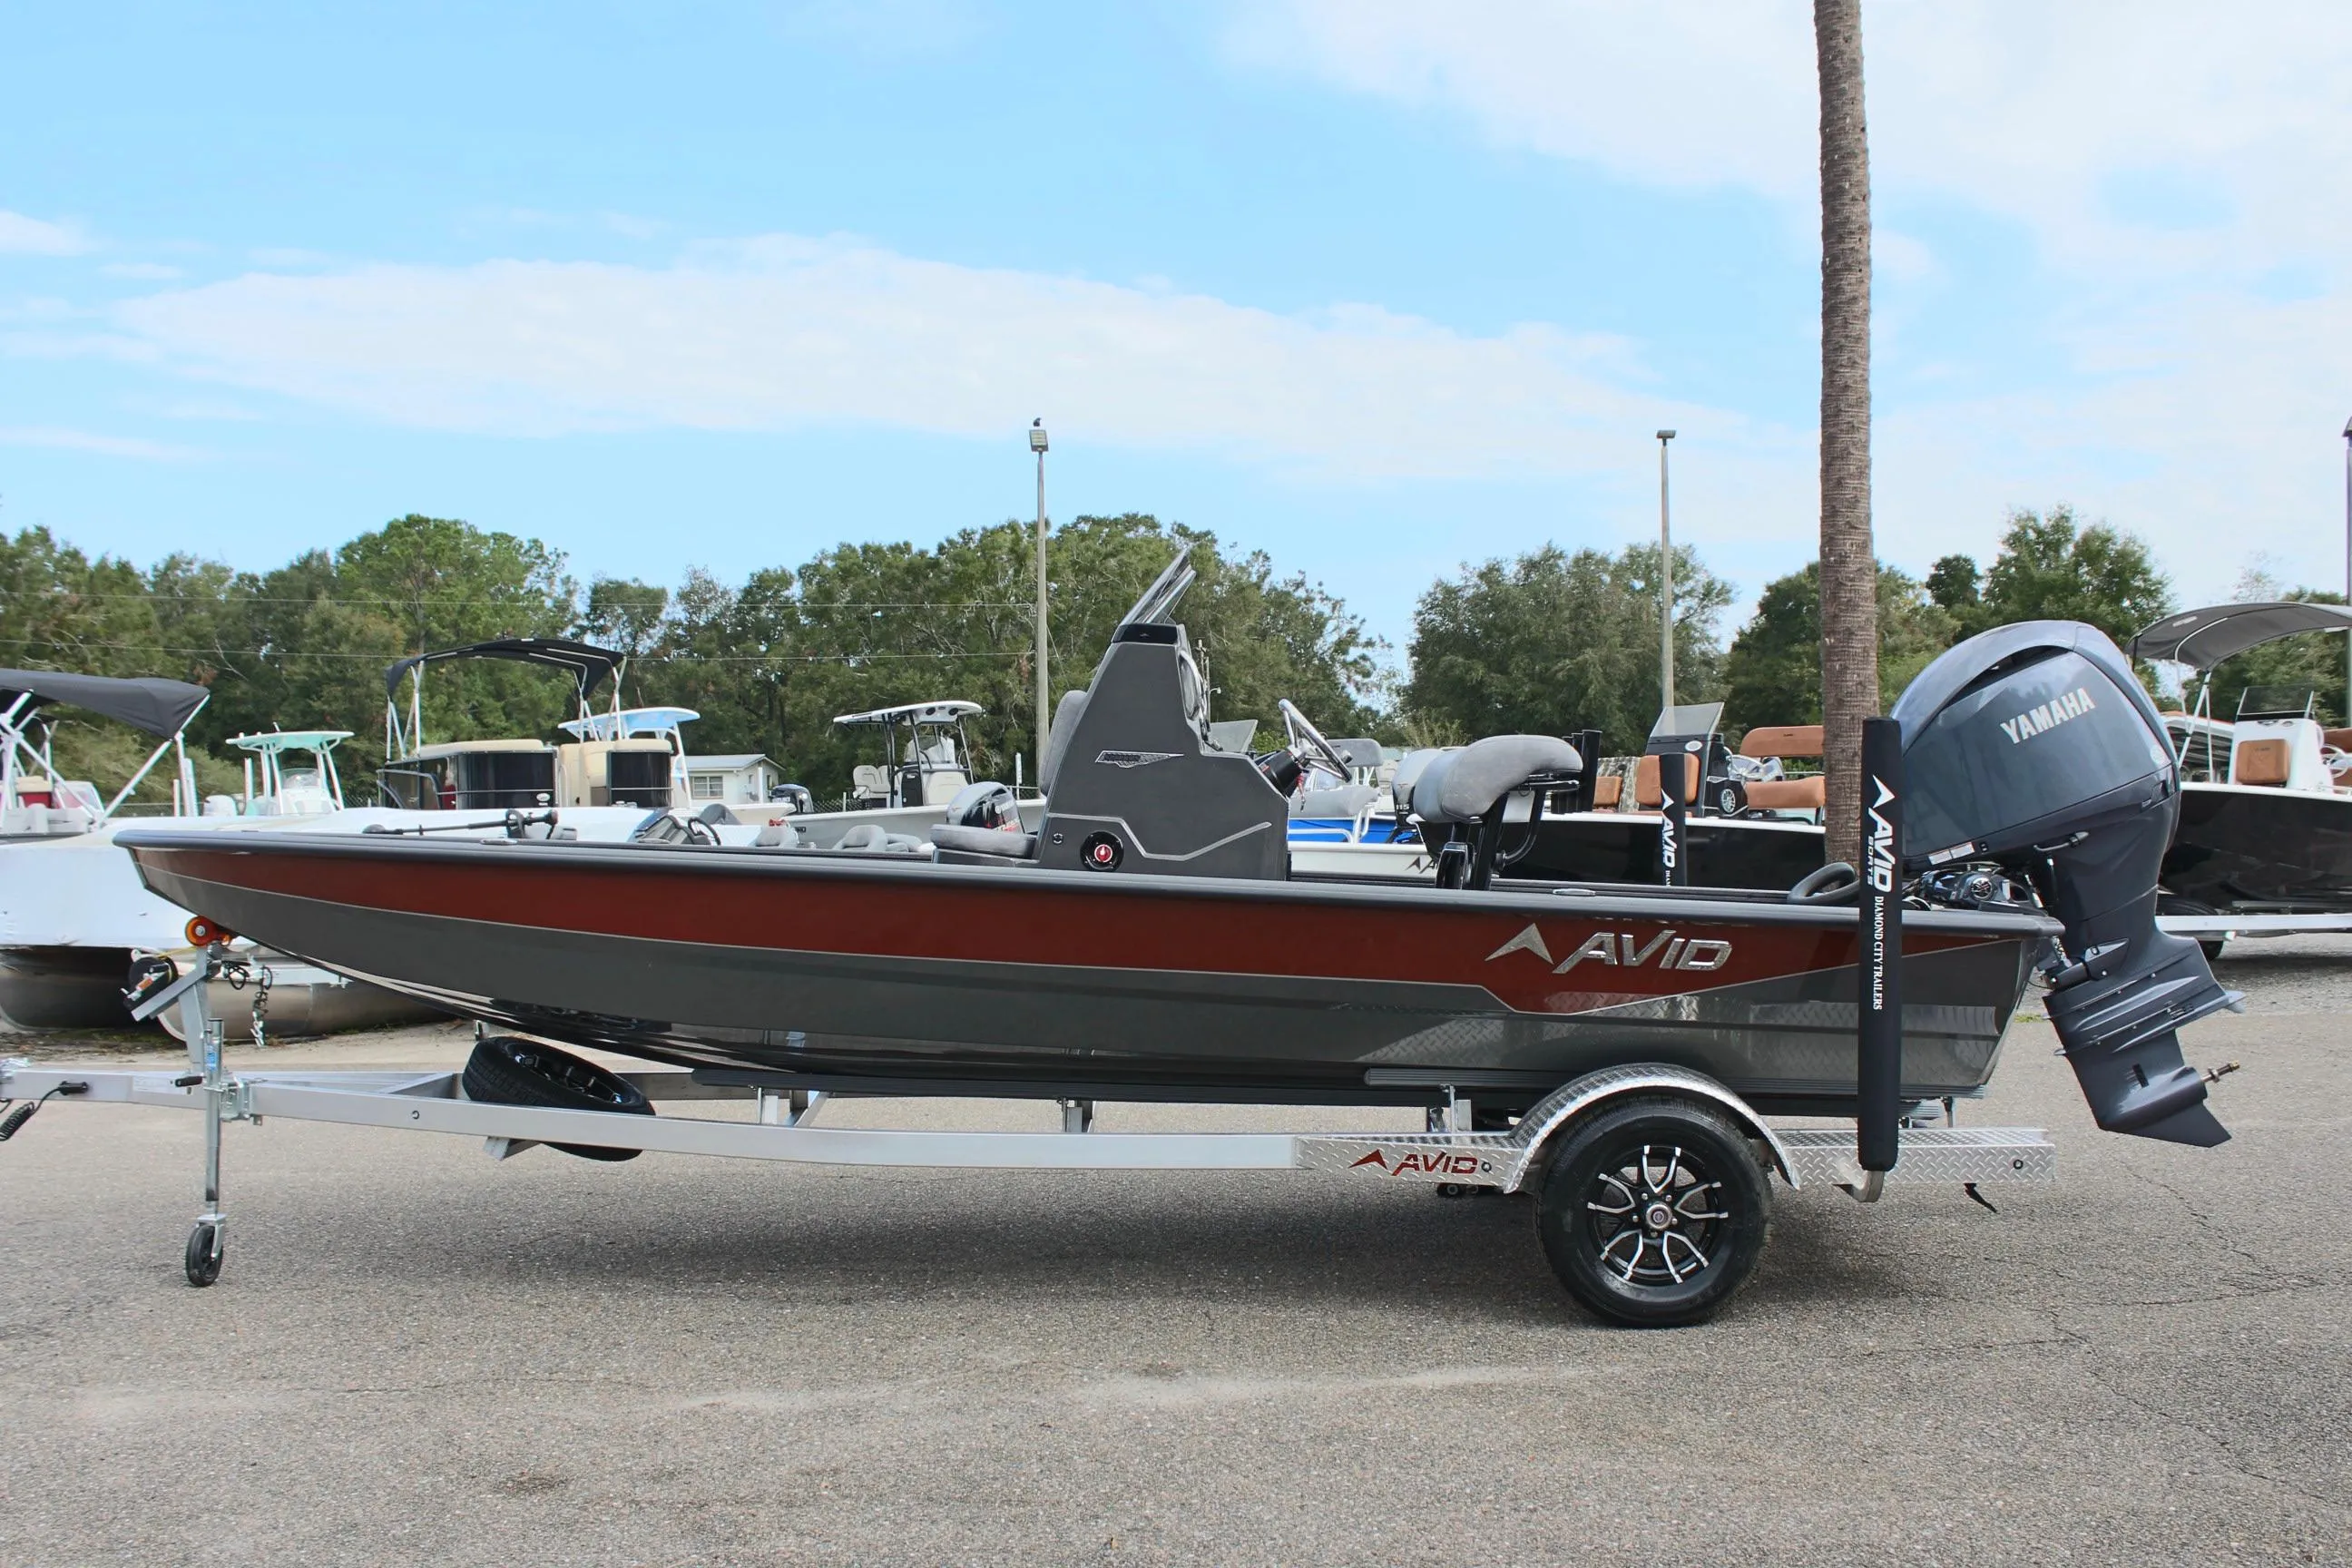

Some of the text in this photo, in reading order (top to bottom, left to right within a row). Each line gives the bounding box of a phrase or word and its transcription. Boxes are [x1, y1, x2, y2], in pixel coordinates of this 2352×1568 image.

[1999, 688, 2096, 744] YAMAHA
[1661, 810, 1678, 868] AVID
[1867, 807, 1896, 893] AVID
[1552, 929, 1733, 975] AVID
[1872, 896, 1885, 1011] DIAMOND CITY TRAILERS
[1391, 1151, 1479, 1177] AVID
